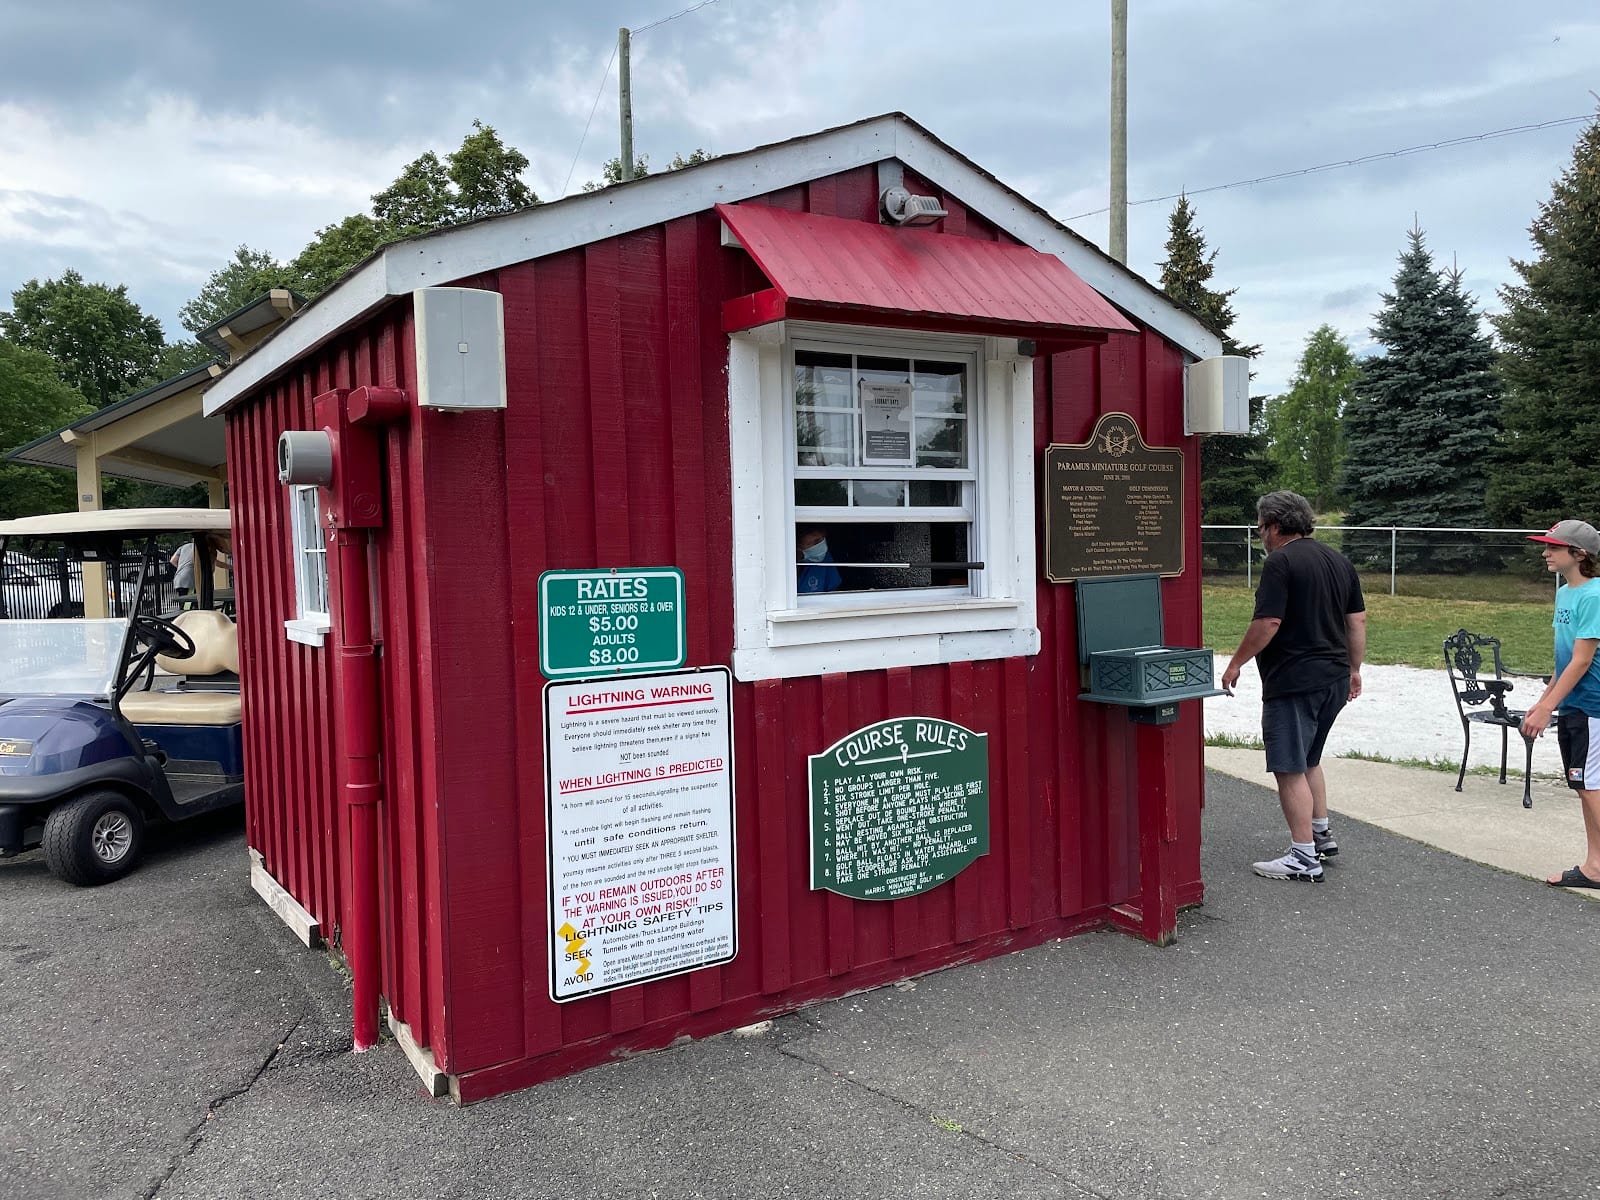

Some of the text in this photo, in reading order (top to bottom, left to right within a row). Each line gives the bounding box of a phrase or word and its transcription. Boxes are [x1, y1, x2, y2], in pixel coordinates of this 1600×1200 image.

[1057, 462, 1090, 471] PARAMUS
[1092, 463, 1128, 471] MINIATURE
[1149, 464, 1174, 472] COURSE
[578, 578, 647, 598] RATES
[550, 602, 673, 617] KIDS 12 & UNDER, SENIORS 62 & OVER
[589, 616, 638, 633] $5.00
[593, 633, 635, 646] ADULTS
[590, 647, 639, 666] $8.00
[569, 683, 712, 707] LIGHTNING WARNING
[565, 732, 590, 742] Everyone
[613, 726, 645, 736] immediately
[663, 722, 680, 730] shelter
[706, 718, 716, 726] they
[0, 742, 16, 752] Car
[836, 723, 968, 767] COURSE RULES
[560, 758, 723, 790] WHEN LIGHTNING IS PREDICTED
[824, 767, 923, 788] 1. PLAY AT YOUR OWN RISK.
[835, 787, 843, 795] NO
[848, 782, 873, 793] GROUPS
[877, 778, 901, 788] LARGER
[905, 775, 921, 784] THAN
[925, 772, 939, 781] FIVE.
[824, 781, 931, 805] 3. SIX STROKE LIMIT PER HOLE.
[824, 808, 831, 816] 4.
[835, 799, 869, 811] EVERYONE
[873, 797, 879, 805] IN
[891, 792, 911, 802] GROUP
[916, 789, 932, 798] MUST
[935, 786, 950, 794] PLAY
[966, 781, 982, 789] FIRST
[836, 787, 983, 818] SHOT BEFORE ANYONE PLAYS HIS SECOND SHOT.
[824, 823, 831, 832] 5.
[836, 815, 864, 826] REPLACE
[868, 812, 880, 820] OUT
[885, 810, 892, 818] OF
[897, 806, 916, 816] BOUND
[920, 803, 935, 811] BALL
[939, 799, 958, 808] WHERE
[836, 804, 966, 833] WENT OUT. TAKE ONE-STROKE PENALTY.
[575, 819, 708, 847] until safe conditions return.
[825, 811, 968, 847] 6. BALL RESTING AGAINST AN OBSTRUCTION
[836, 825, 928, 848] MAY BE MOVED SIX INCHES.
[562, 867, 724, 907] IF YOU REMAIN OUTDOORS AFTER
[565, 907, 582, 919] THE
[586, 898, 627, 915] WARNING
[631, 896, 639, 906] IS
[696, 882, 707, 893] DO
[711, 879, 722, 890] SO
[865, 886, 885, 895] HARRIS
[889, 880, 917, 890] MINIATURE
[565, 902, 723, 943] LIGHTNING SAFETY TIPS
[583, 897, 698, 929] AT YOUR OWN RISK!!!
[680, 918, 705, 930] Buildings
[603, 944, 628, 955] Tunnels
[630, 940, 644, 949] with
[657, 931, 684, 944] standing
[687, 927, 704, 936] water
[565, 948, 593, 962] SEEK
[564, 972, 594, 987] AVOID
